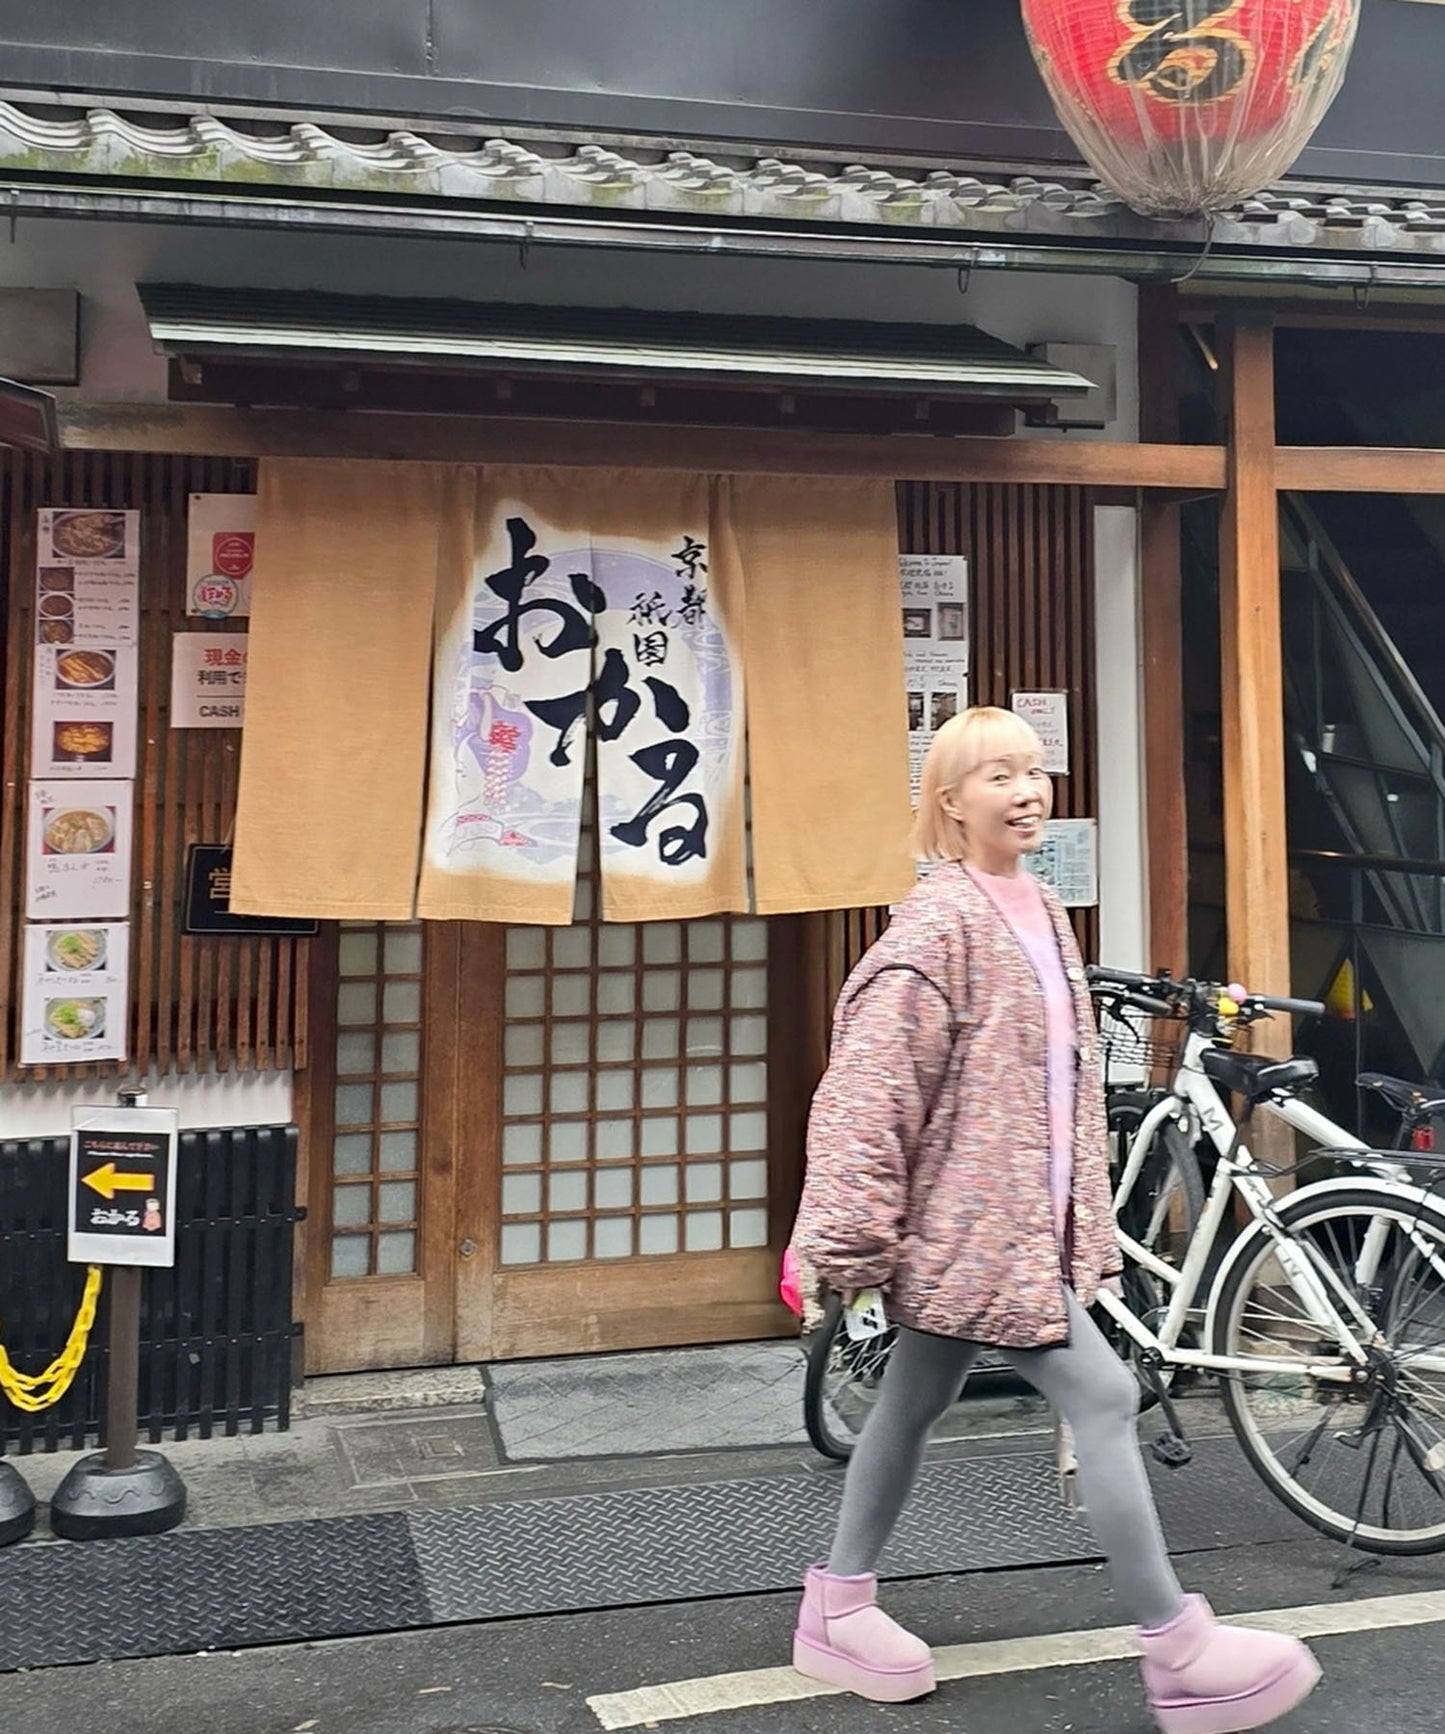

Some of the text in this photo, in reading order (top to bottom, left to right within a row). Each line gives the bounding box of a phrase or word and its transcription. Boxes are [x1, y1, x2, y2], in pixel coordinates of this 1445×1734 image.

[670, 536, 709, 630] 京都
[197, 669, 246, 685] 利用で
[473, 517, 709, 865] おかる
[199, 705, 240, 717] CASH
